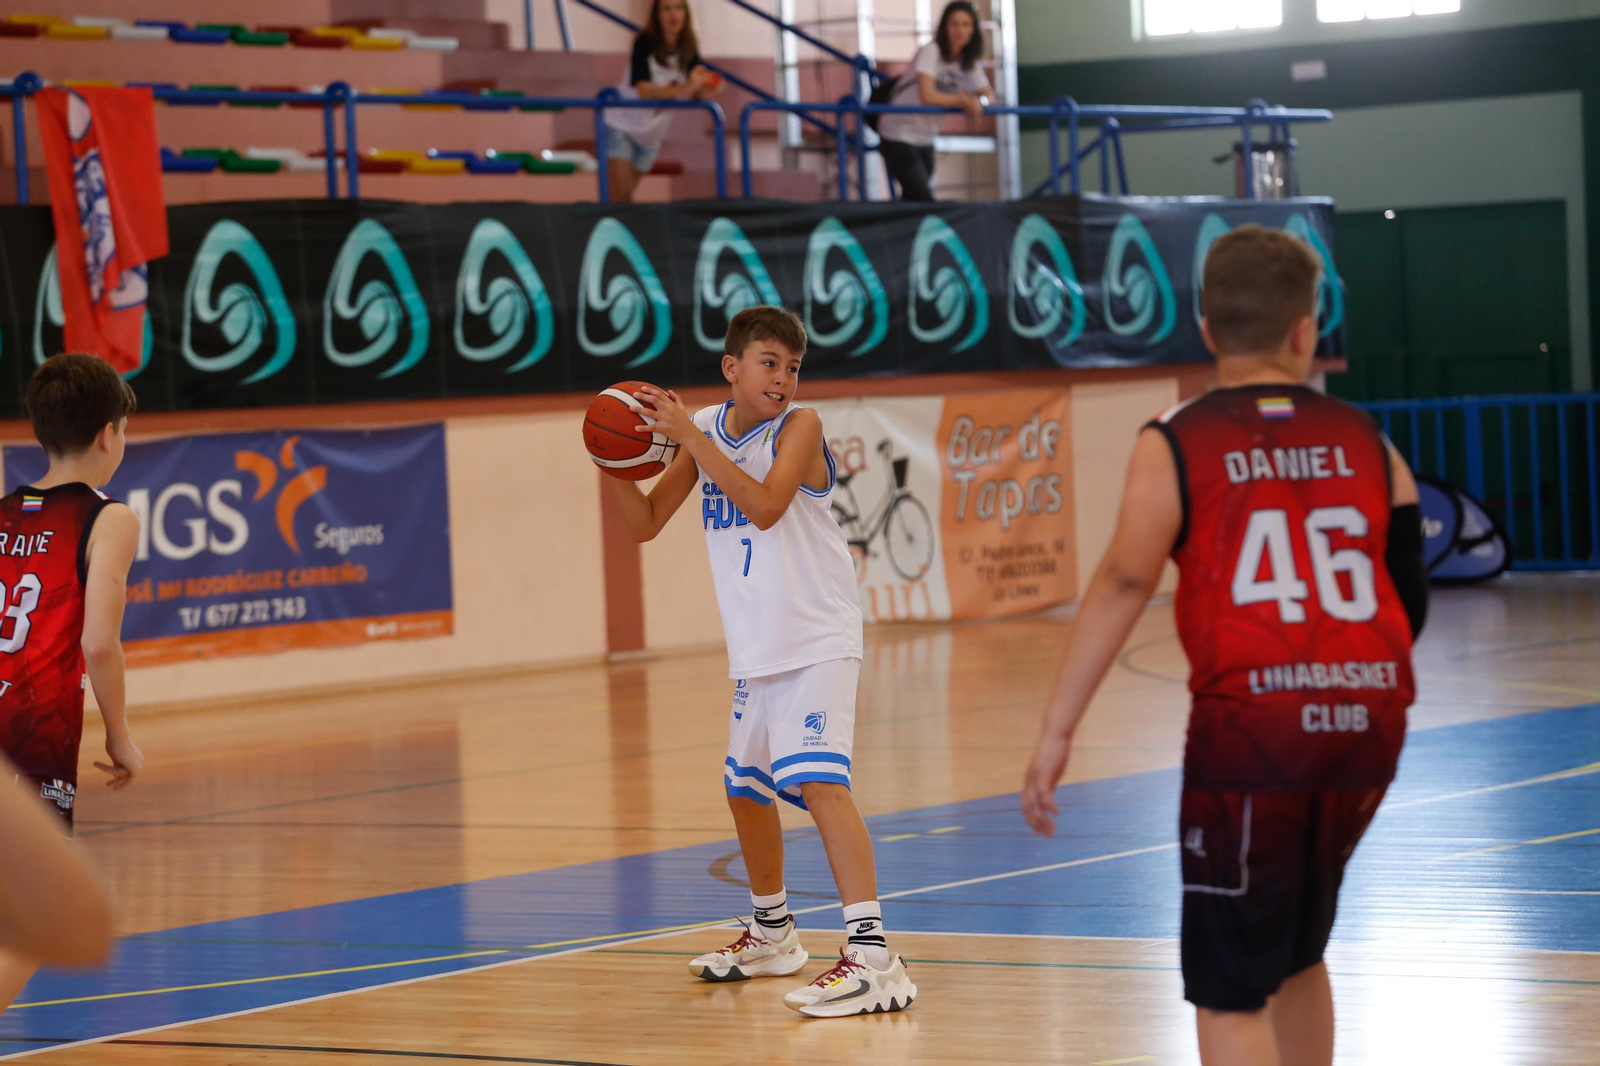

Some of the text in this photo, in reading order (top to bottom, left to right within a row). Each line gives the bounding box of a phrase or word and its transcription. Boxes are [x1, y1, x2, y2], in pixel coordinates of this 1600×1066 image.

[828, 435, 868, 475] sa
[947, 407, 1061, 467] Bar de
[1223, 445, 1355, 484] DANIEL
[702, 497, 752, 530] HUE
[952, 469, 1063, 531] Tapas
[314, 522, 384, 554] Seguros
[741, 538, 752, 577] 7
[1230, 505, 1379, 624] 46
[185, 569, 284, 597] RODRÍGUEZ
[286, 560, 368, 588] CARREÑO
[205, 603, 239, 628] 677
[271, 596, 307, 620] 743
[1248, 660, 1398, 695] LINABASKET
[1301, 703, 1369, 733] CLUB
[859, 921, 875, 930] NIKE
